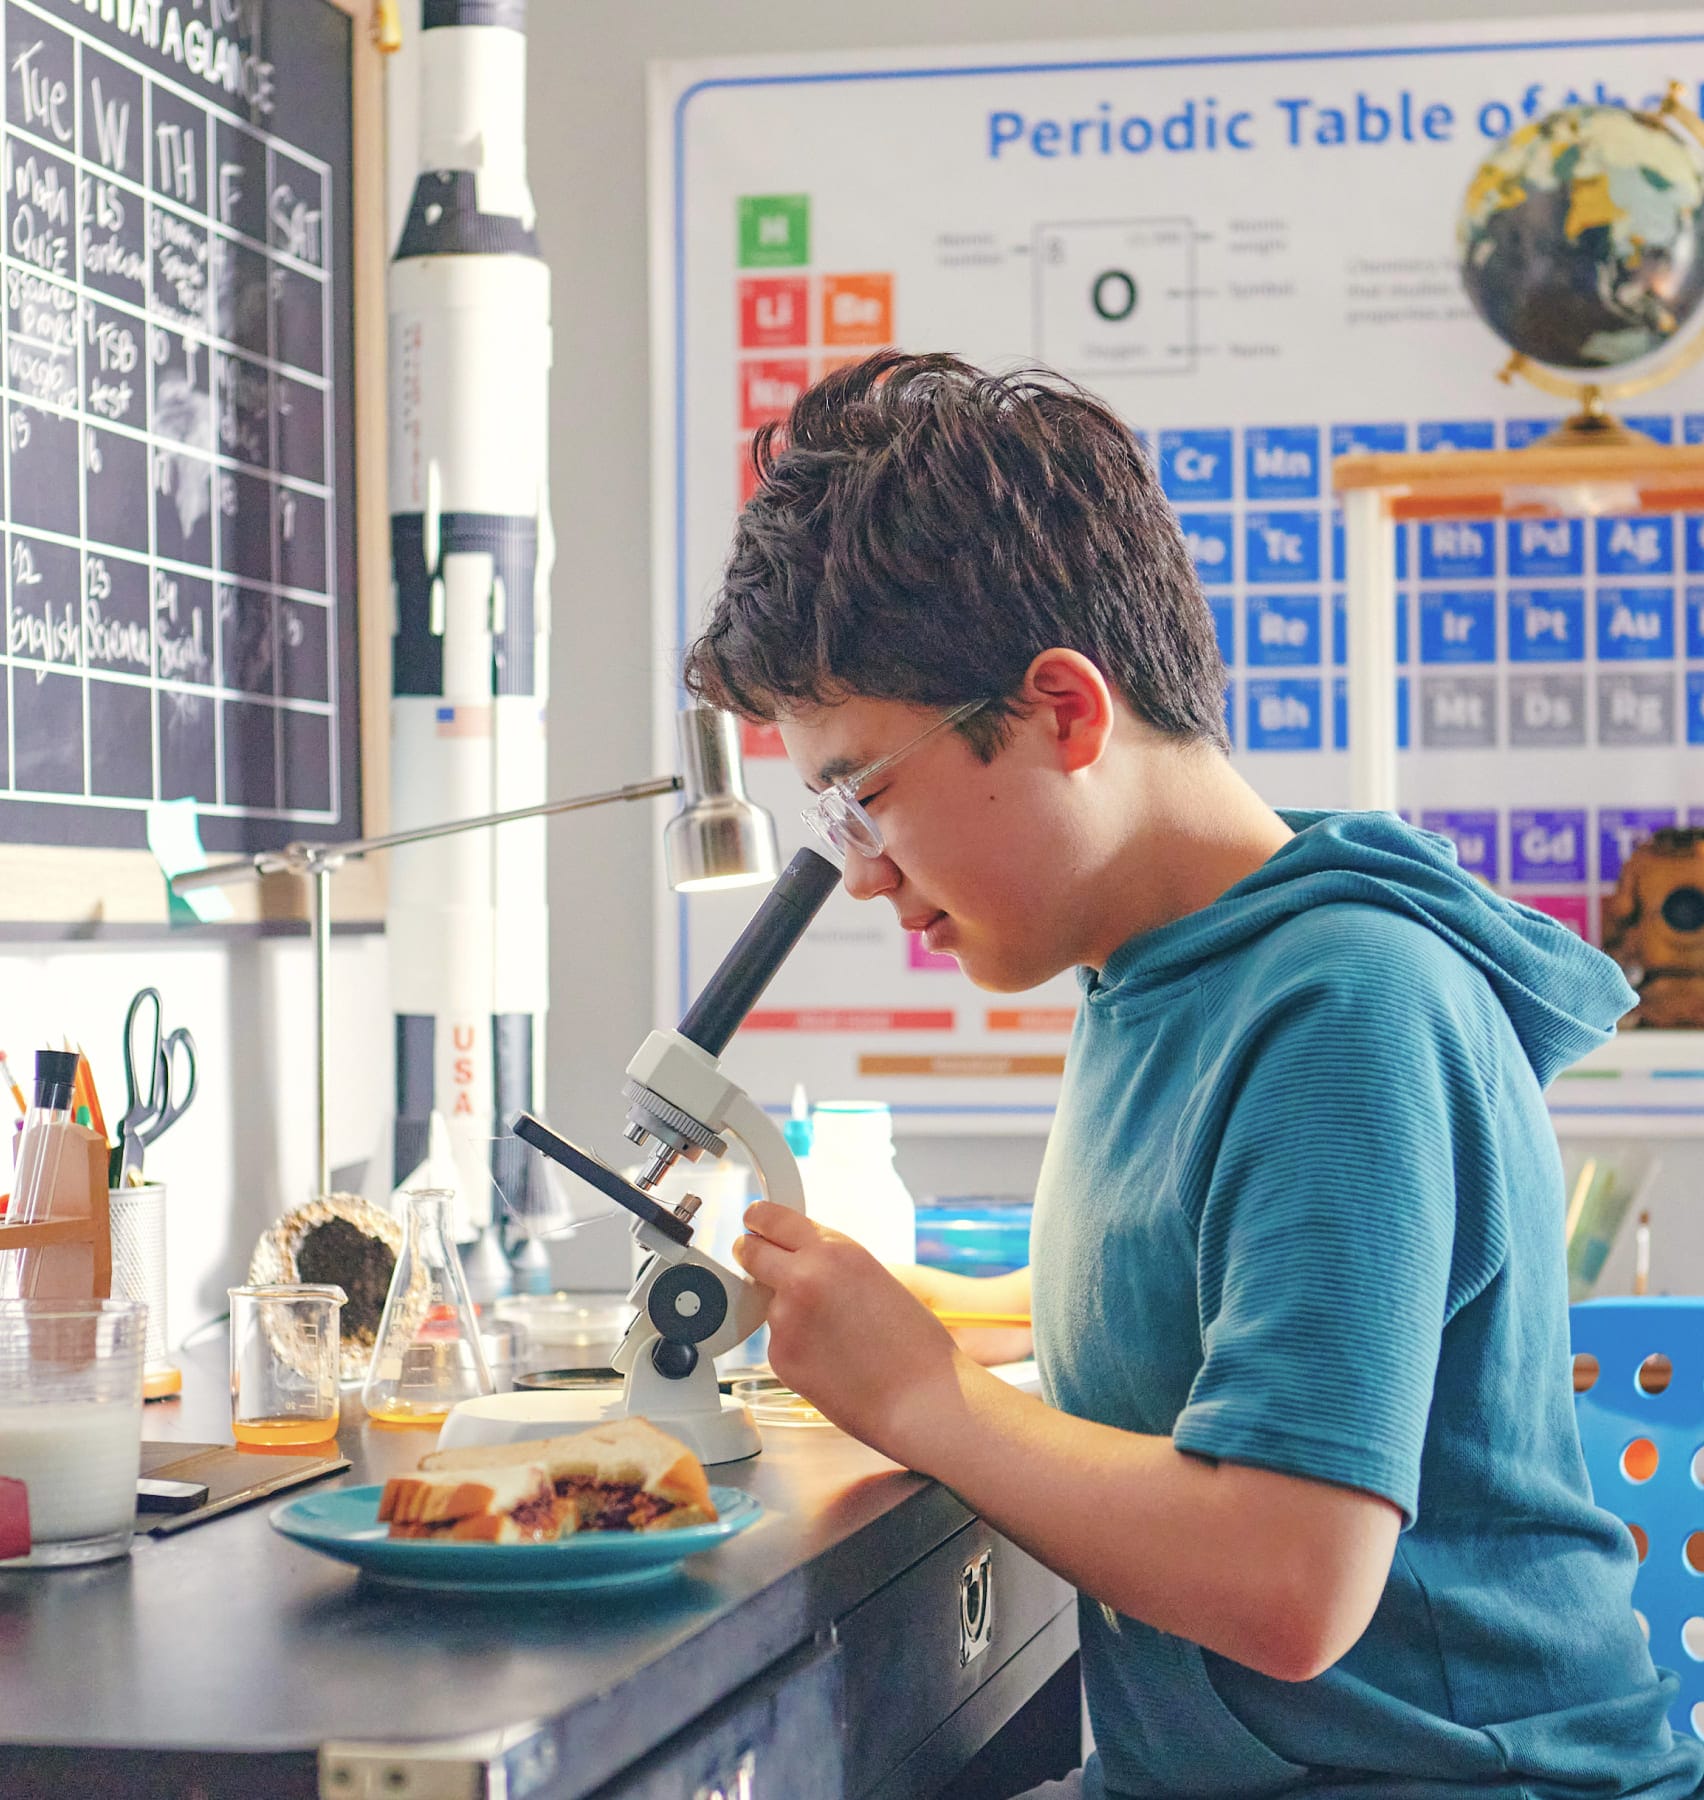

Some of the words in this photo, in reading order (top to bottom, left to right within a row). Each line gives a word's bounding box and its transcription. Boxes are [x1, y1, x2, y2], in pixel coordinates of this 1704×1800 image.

[11, 40, 73, 142] Tue
[91, 76, 130, 172] W
[988, 99, 1254, 158] Periodic
[1276, 91, 1454, 147] Table
[1478, 84, 1542, 138] of
[156, 121, 197, 203] TH
[219, 162, 246, 224] F
[12, 203, 69, 277] Quiz
[758, 214, 790, 247] H
[755, 292, 793, 329] Li
[832, 294, 882, 326] Be
[1091, 269, 1137, 322] O
[1174, 448, 1218, 481] Cr
[1253, 446, 1311, 479] Mn
[1263, 528, 1303, 564] Tc
[1432, 519, 1484, 558] Rh
[1521, 516, 1571, 557] Pd
[1608, 521, 1662, 565] Ag
[1259, 613, 1310, 647] Re
[1443, 609, 1476, 643] Ir
[1524, 607, 1568, 641] Pt
[1608, 606, 1662, 640] Au
[10, 600, 80, 685] English
[1259, 696, 1311, 731] Bh
[1523, 690, 1573, 727] Ds
[1521, 828, 1575, 864] Gd
[453, 1024, 474, 1116] USA
